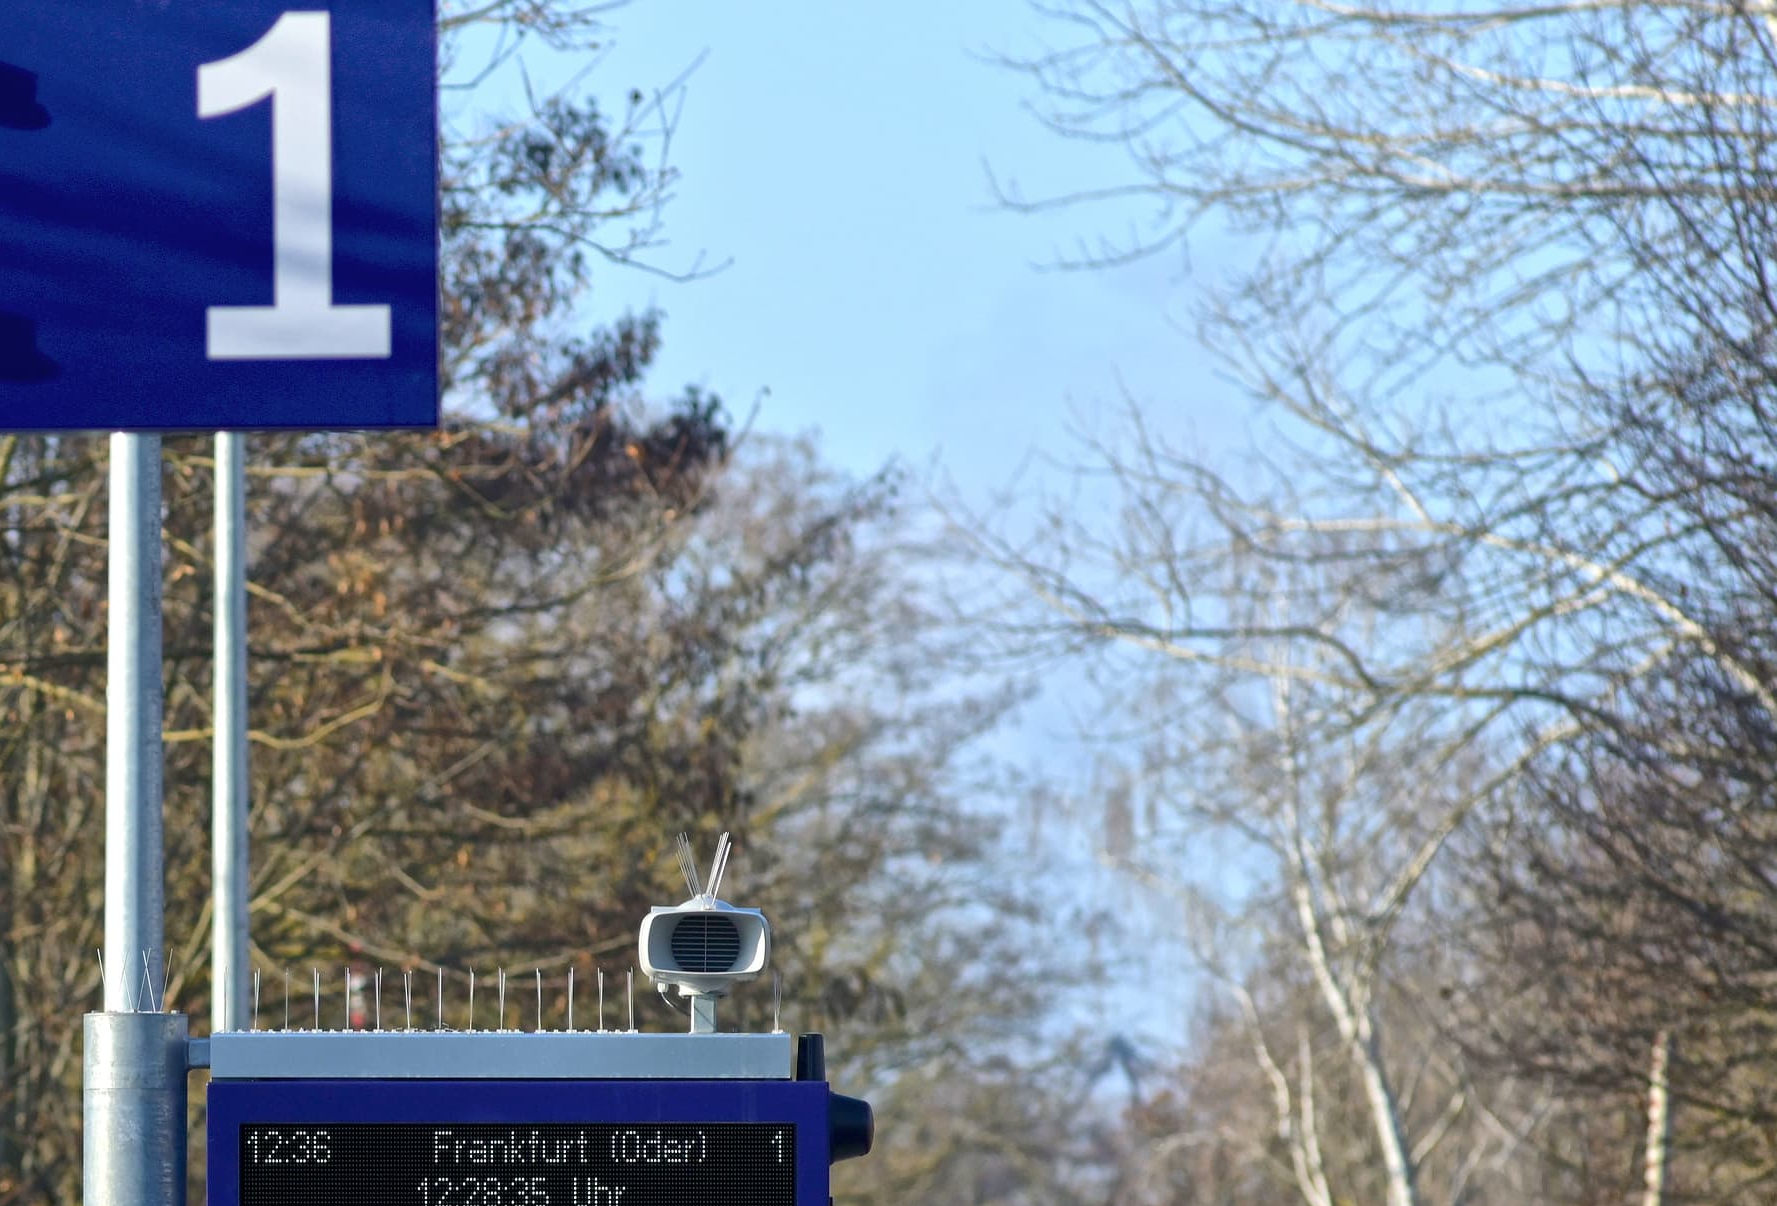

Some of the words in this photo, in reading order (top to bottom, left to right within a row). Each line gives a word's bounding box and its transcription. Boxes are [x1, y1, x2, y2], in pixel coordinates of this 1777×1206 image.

[198, 11, 390, 358] 1
[247, 1130, 331, 1163] 12:36
[434, 1130, 588, 1163] Frankfurt
[611, 1130, 706, 1163] (Oder)
[771, 1130, 784, 1163] 1
